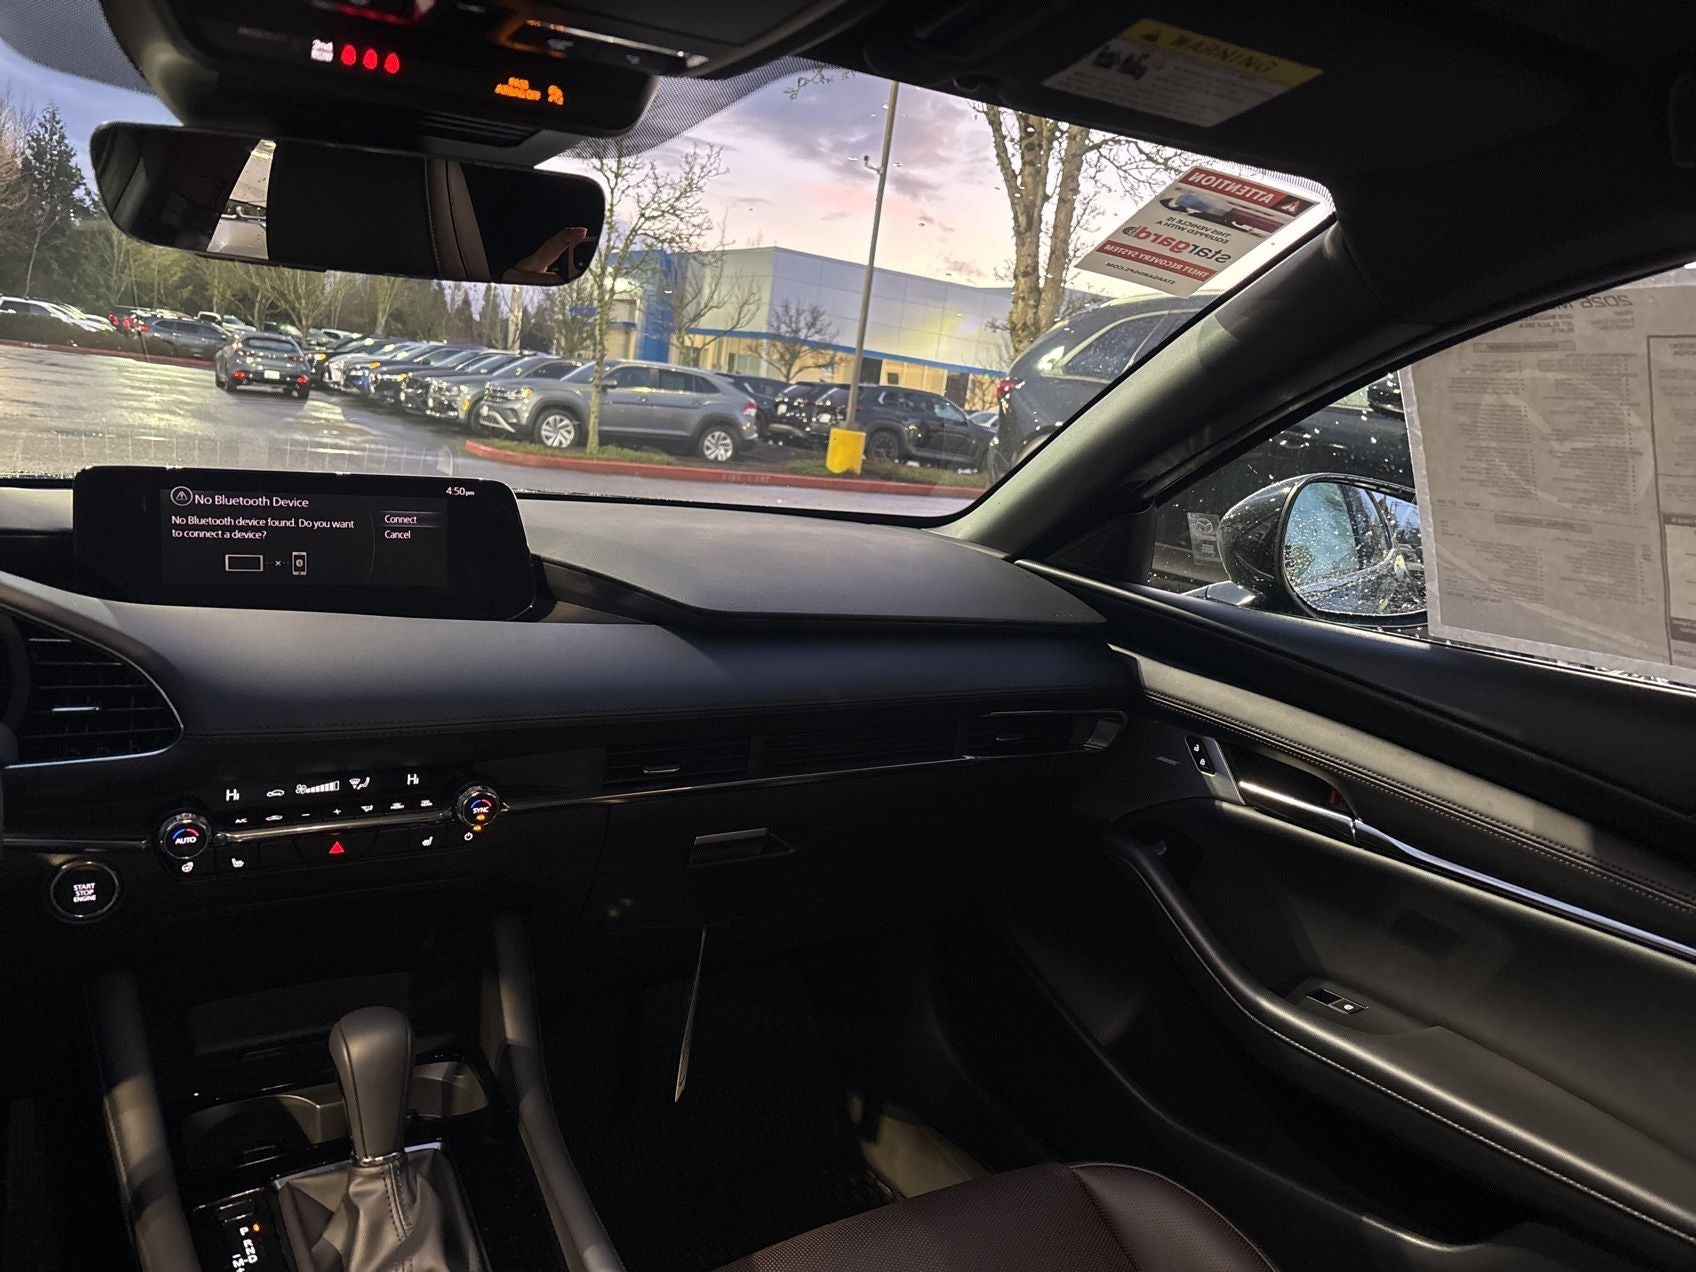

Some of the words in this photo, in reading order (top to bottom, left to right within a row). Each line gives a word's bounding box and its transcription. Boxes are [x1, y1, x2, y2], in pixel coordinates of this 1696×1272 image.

[1170, 34, 1277, 72] WARNING
[194, 494, 213, 505] No
[214, 495, 270, 507] Bluetooth
[272, 497, 309, 508] Device
[171, 515, 187, 525] No
[188, 515, 234, 526] Bluetooth
[235, 516, 265, 527] device
[267, 517, 297, 527] found.
[298, 518, 313, 528] Do
[313, 521, 332, 531] you
[331, 520, 354, 528] want
[384, 514, 417, 524] Connect
[172, 530, 183, 538] to
[183, 530, 223, 538] connect
[231, 530, 267, 539] device?
[384, 530, 411, 539] Cancel
[472, 806, 490, 814] SYNC
[174, 836, 197, 845] AUTO
[73, 882, 96, 891] START
[75, 889, 95, 897] STOP
[240, 1227, 249, 1236] P
